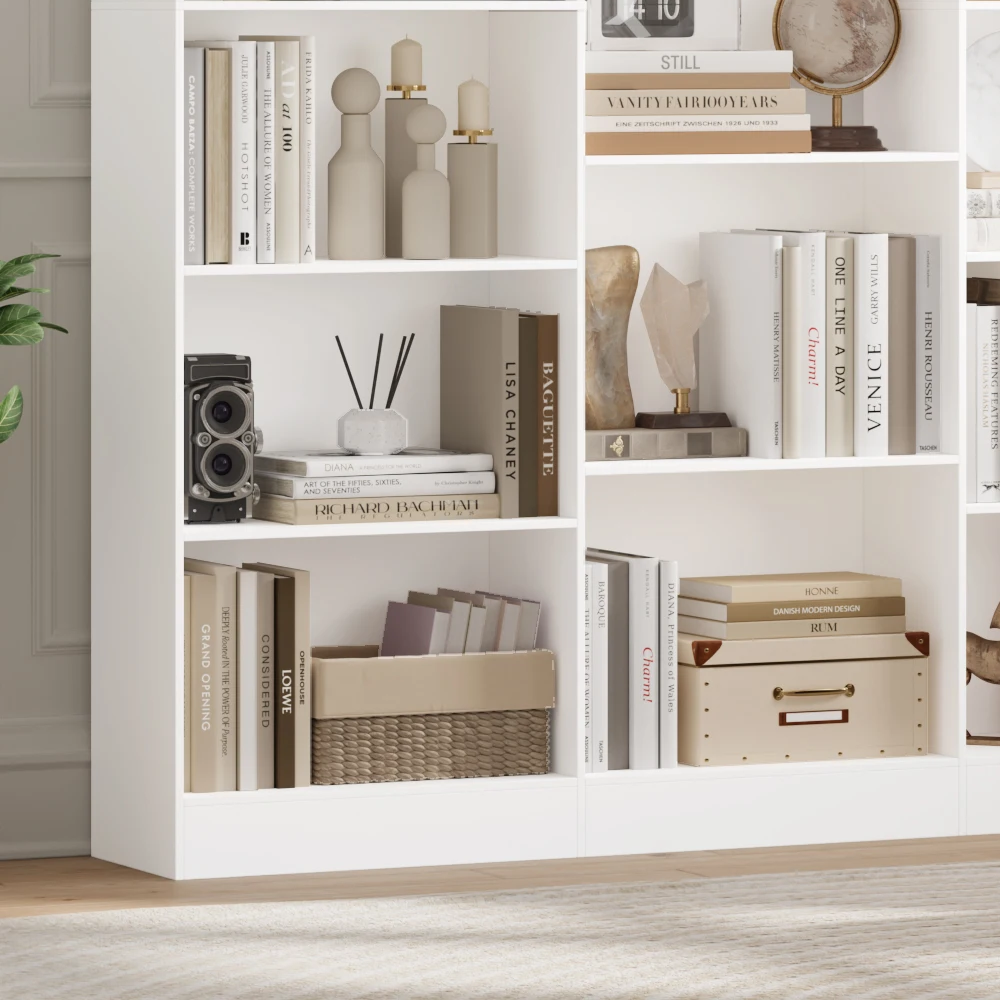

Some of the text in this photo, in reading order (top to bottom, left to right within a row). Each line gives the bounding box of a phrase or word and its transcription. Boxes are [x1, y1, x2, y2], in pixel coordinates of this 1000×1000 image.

[281, 60, 296, 99] AD
[661, 55, 700, 70] STILL
[282, 103, 293, 152] at 100
[608, 96, 662, 108] VANITY
[188, 75, 196, 252] CAMPO BAEZA: COMPLETE WORKS
[240, 142, 249, 212] HOTSHOT
[870, 254, 878, 325] GARRY WILLS
[835, 256, 845, 396] ONE LINE A DAY
[808, 326, 820, 387] Charm!
[868, 342, 882, 432] VENICE
[505, 362, 516, 480] LISA CHANEY
[542, 362, 554, 476] BAGUETTE
[319, 480, 331, 488] OF
[348, 479, 373, 487] FIFTIES,
[324, 463, 354, 472] DIANA
[315, 500, 479, 515] RICHARD BACHMAN
[773, 605, 861, 615] DANISH MODERN DESIGN
[805, 586, 838, 596] HONNE
[667, 583, 675, 713] DIANA, Princess of Wales
[810, 623, 838, 632] RUM
[201, 624, 211, 731] GRAND OPENING
[220, 606, 230, 757] DEEPLY Rooted IN THE POWER OF Purpose.
[261, 634, 270, 728] CONSIDERED
[282, 669, 292, 714] LOEWE
[642, 647, 653, 703] Charm!
